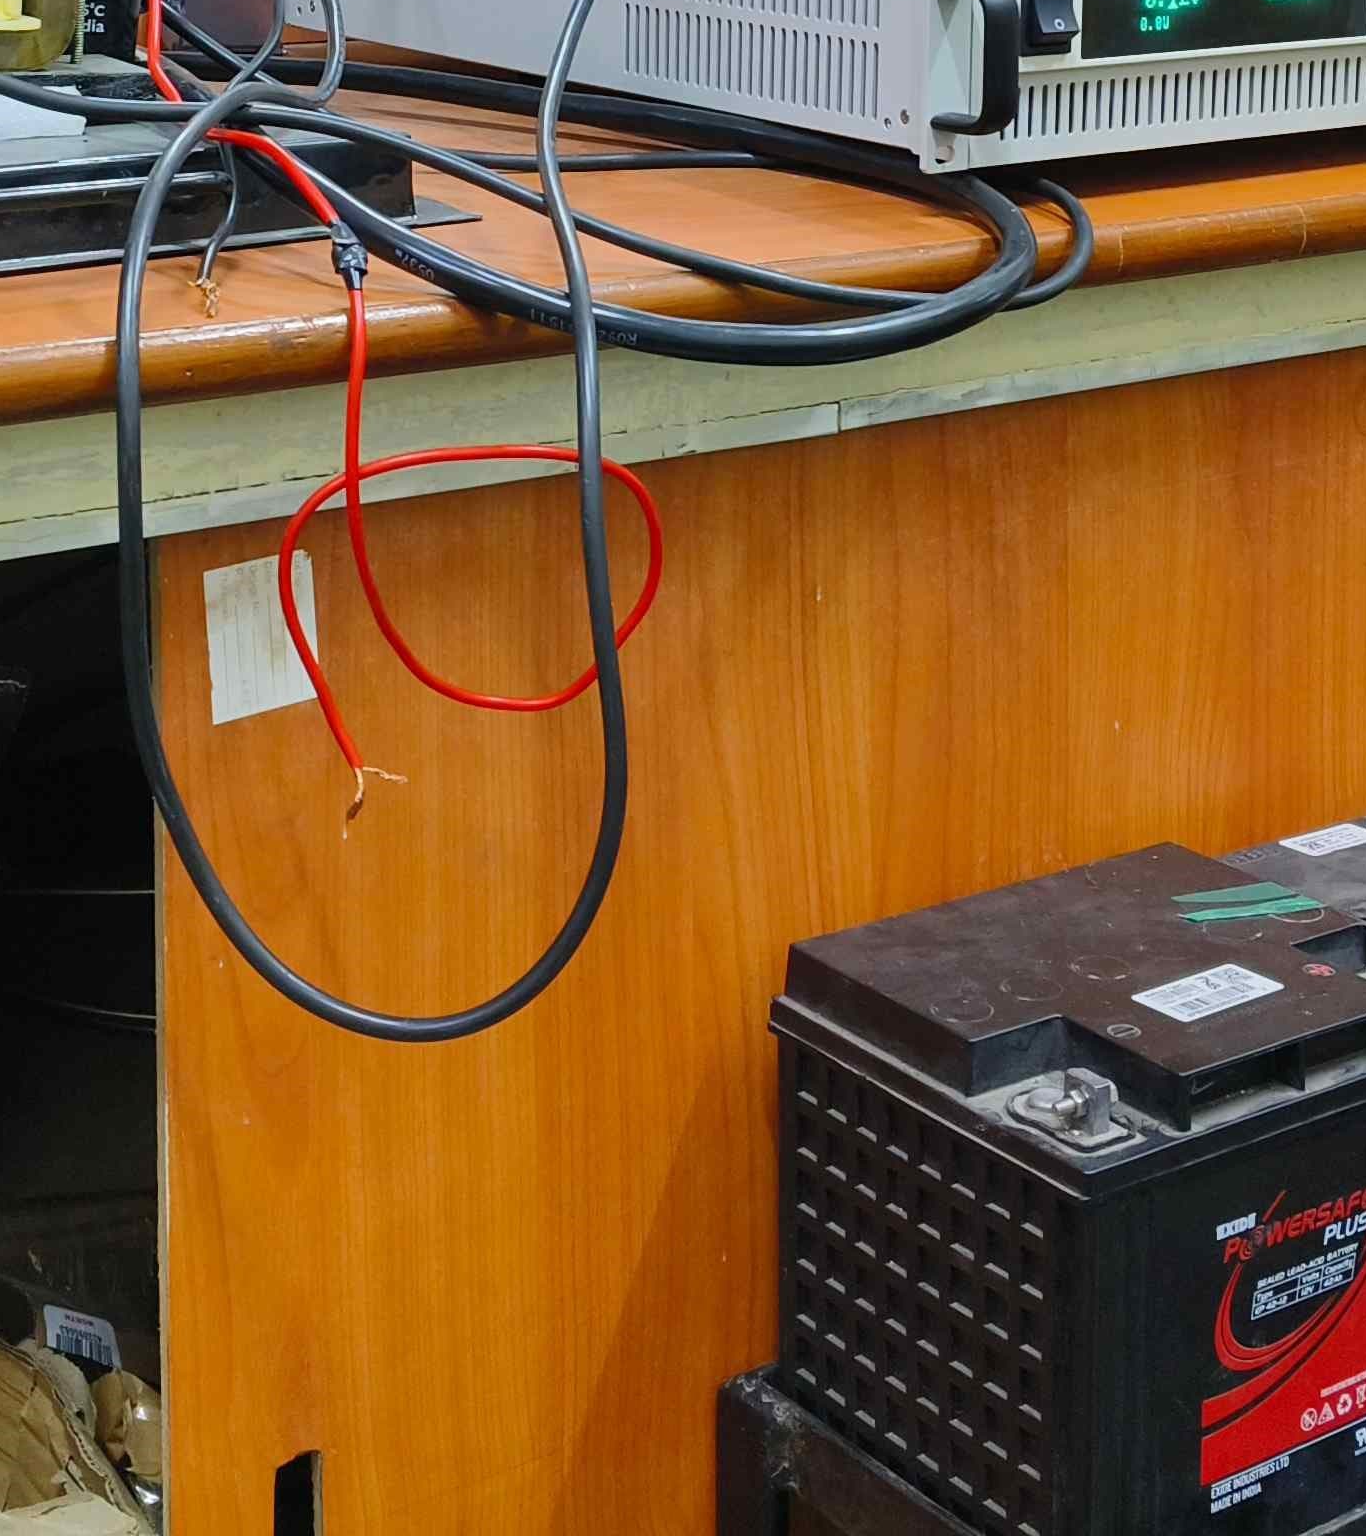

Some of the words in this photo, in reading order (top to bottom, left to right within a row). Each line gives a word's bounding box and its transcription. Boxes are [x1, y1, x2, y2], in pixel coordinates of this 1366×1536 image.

[1326, 1242, 1359, 1262] BATTERY
[1211, 1484, 1232, 1500] EXIDE
[1233, 1462, 1275, 1490] INDUSTRIES
[1276, 1455, 1290, 1472] LTD
[1211, 1494, 1232, 1514] MADE
[1233, 1491, 1241, 1504] IN
[1242, 1482, 1262, 1500] INDIA
